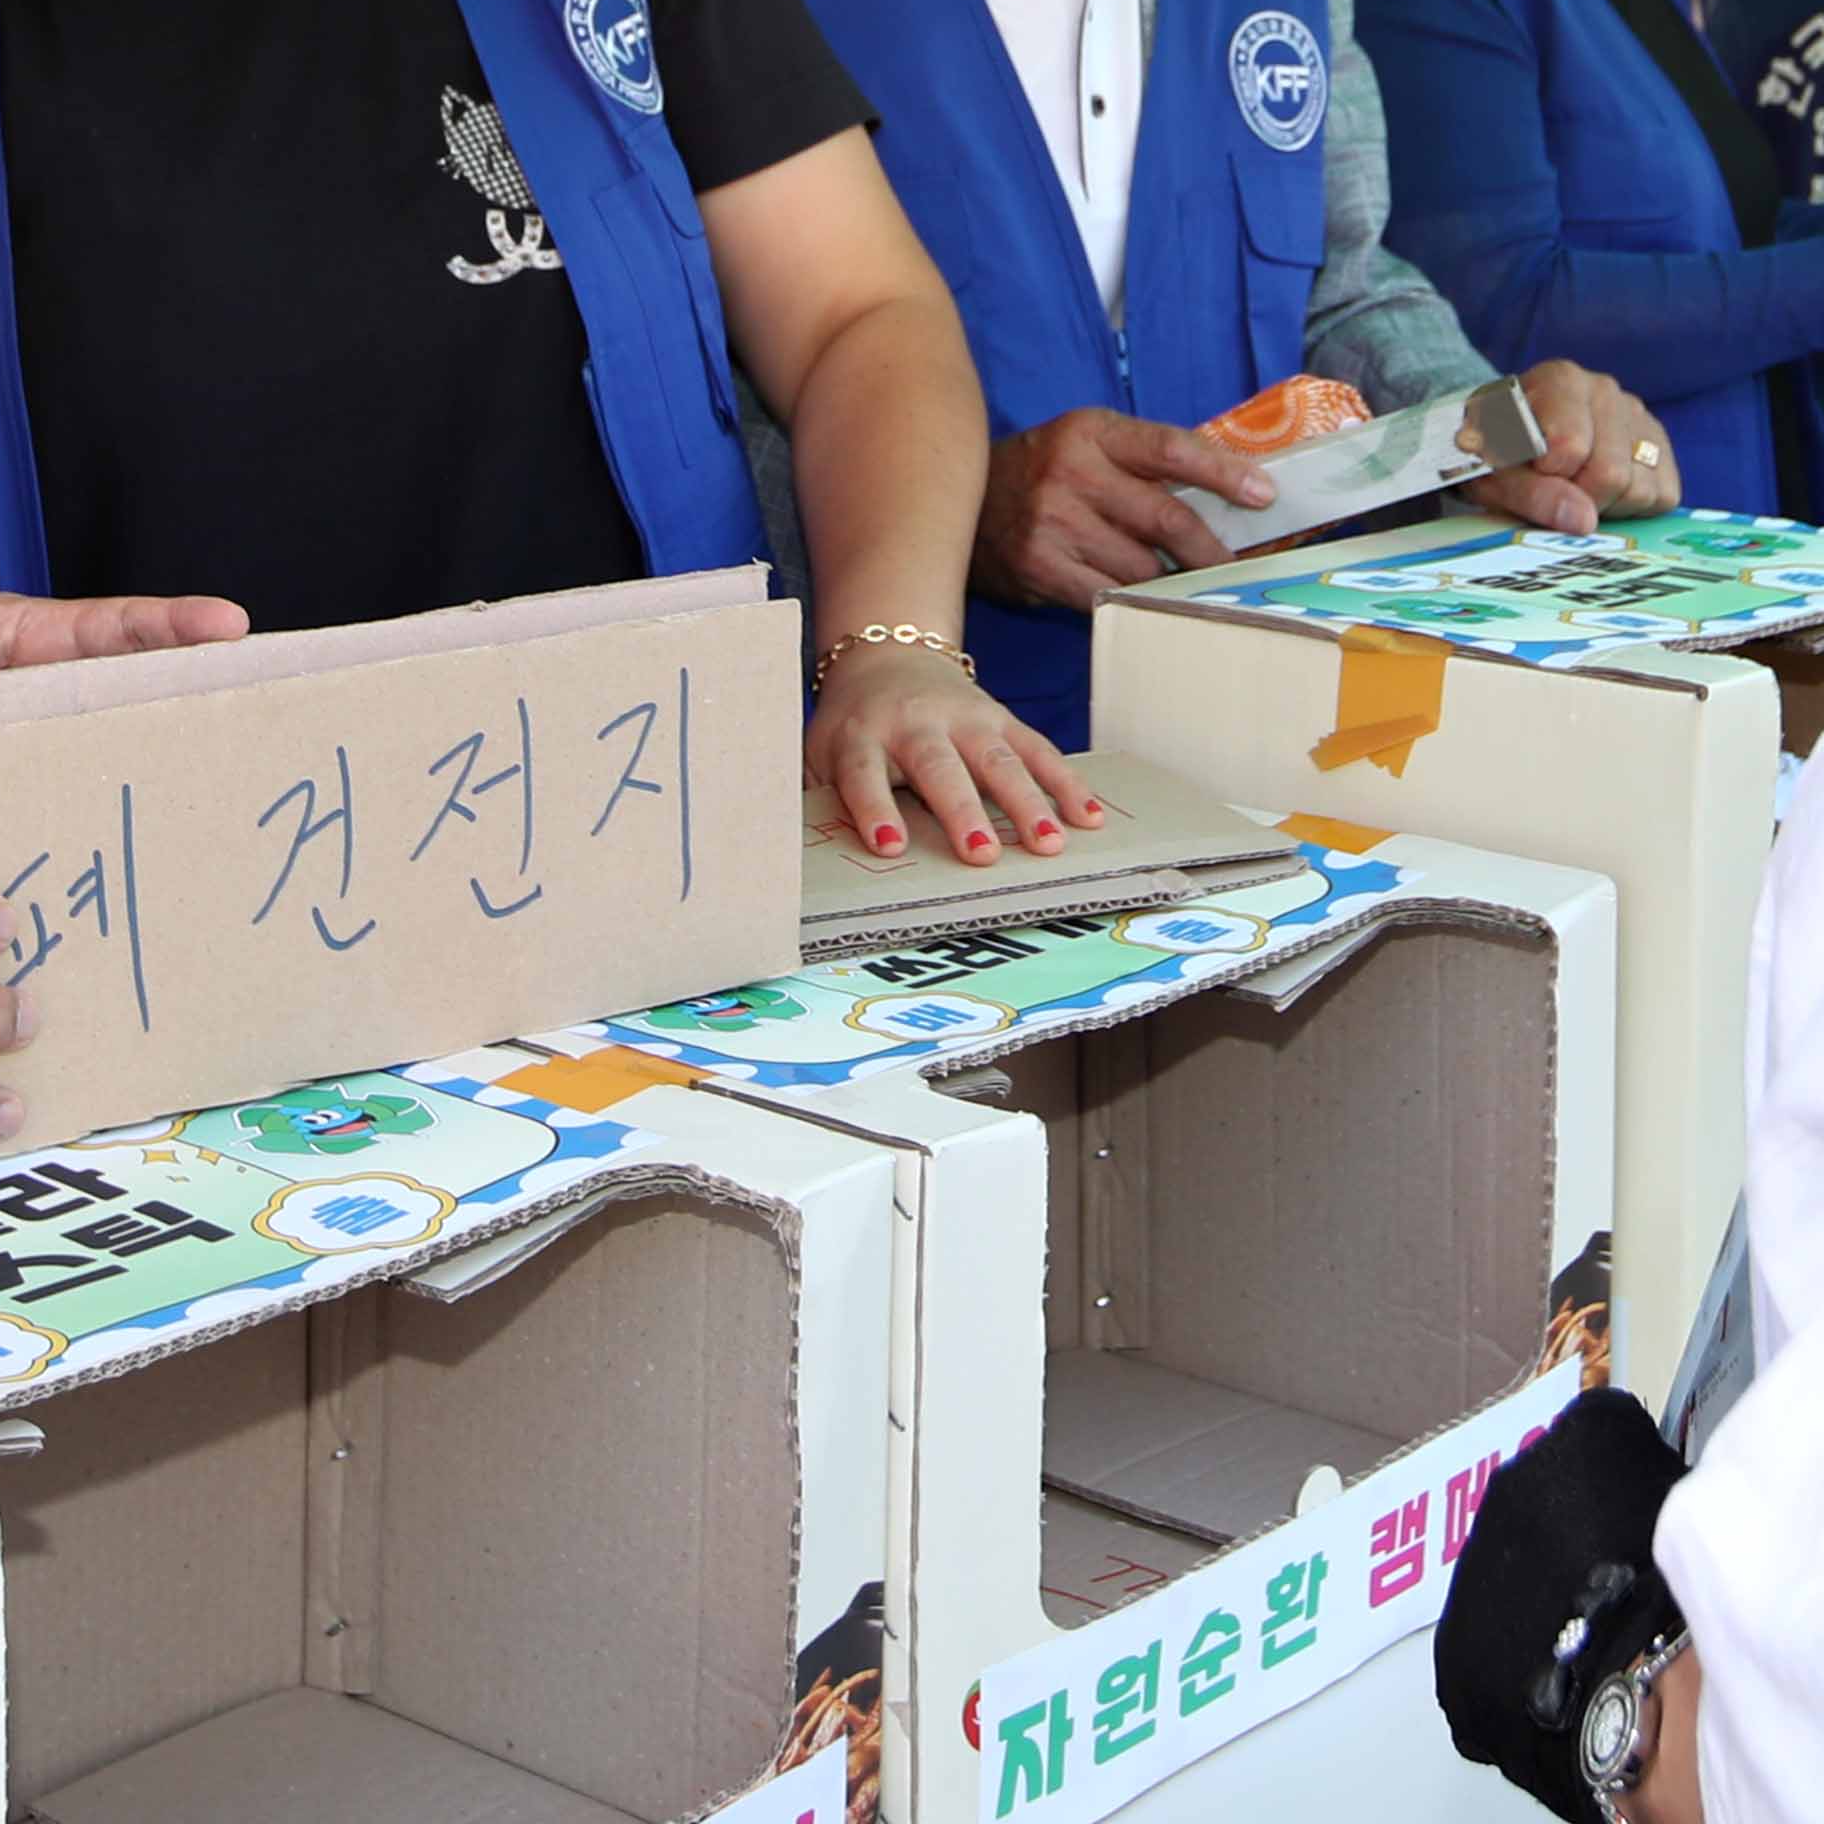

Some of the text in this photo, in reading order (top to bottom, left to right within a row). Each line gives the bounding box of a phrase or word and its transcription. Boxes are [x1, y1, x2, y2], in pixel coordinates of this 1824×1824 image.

[1254, 64, 1311, 103] KFF
[251, 666, 690, 954] 건전지
[994, 1414, 1563, 1821] 자원순환 캠페
